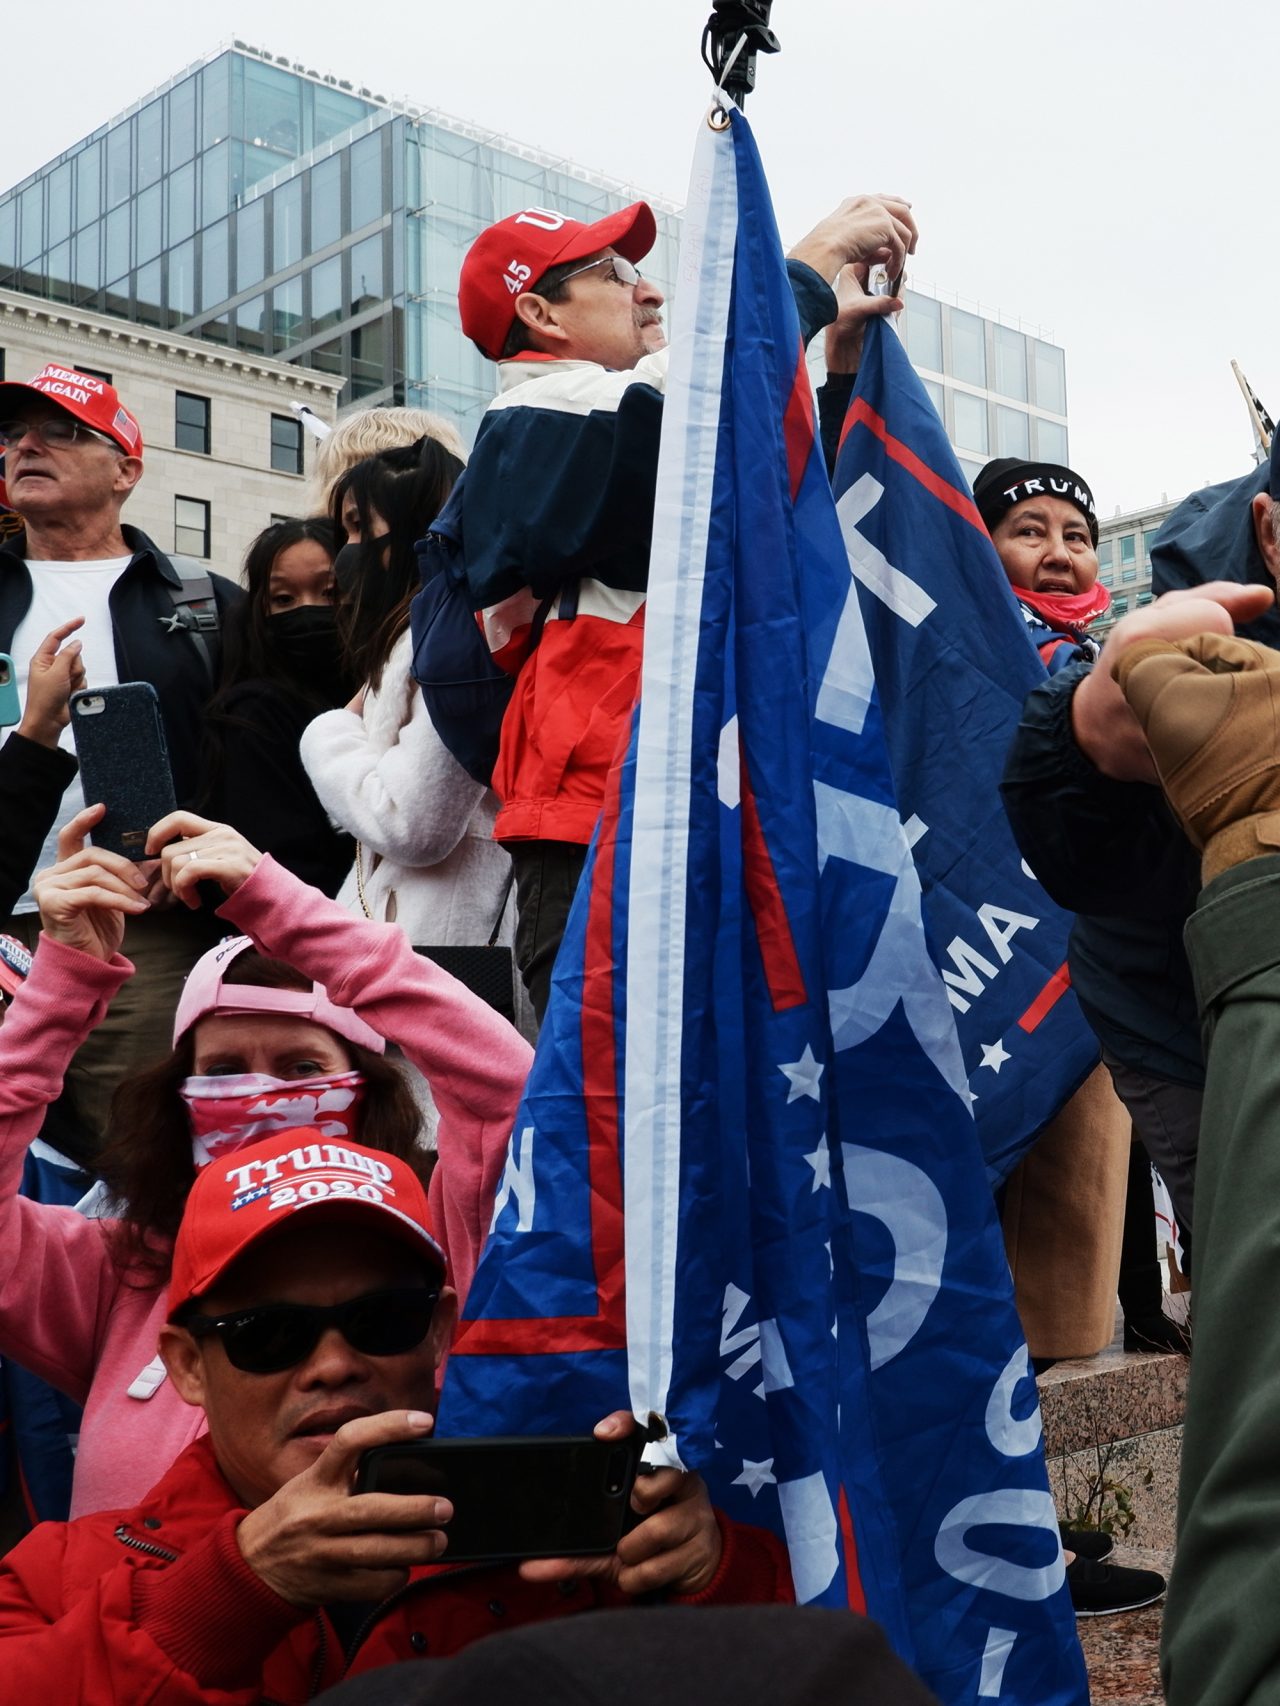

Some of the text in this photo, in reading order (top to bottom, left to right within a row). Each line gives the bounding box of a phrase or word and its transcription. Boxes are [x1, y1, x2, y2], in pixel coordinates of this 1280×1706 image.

[502, 259, 532, 295] 45
[41, 381, 92, 405] AGAIN
[6, 951, 28, 972] 2020
[225, 1144, 393, 1195] Trump
[268, 1180, 384, 1211] 2020
